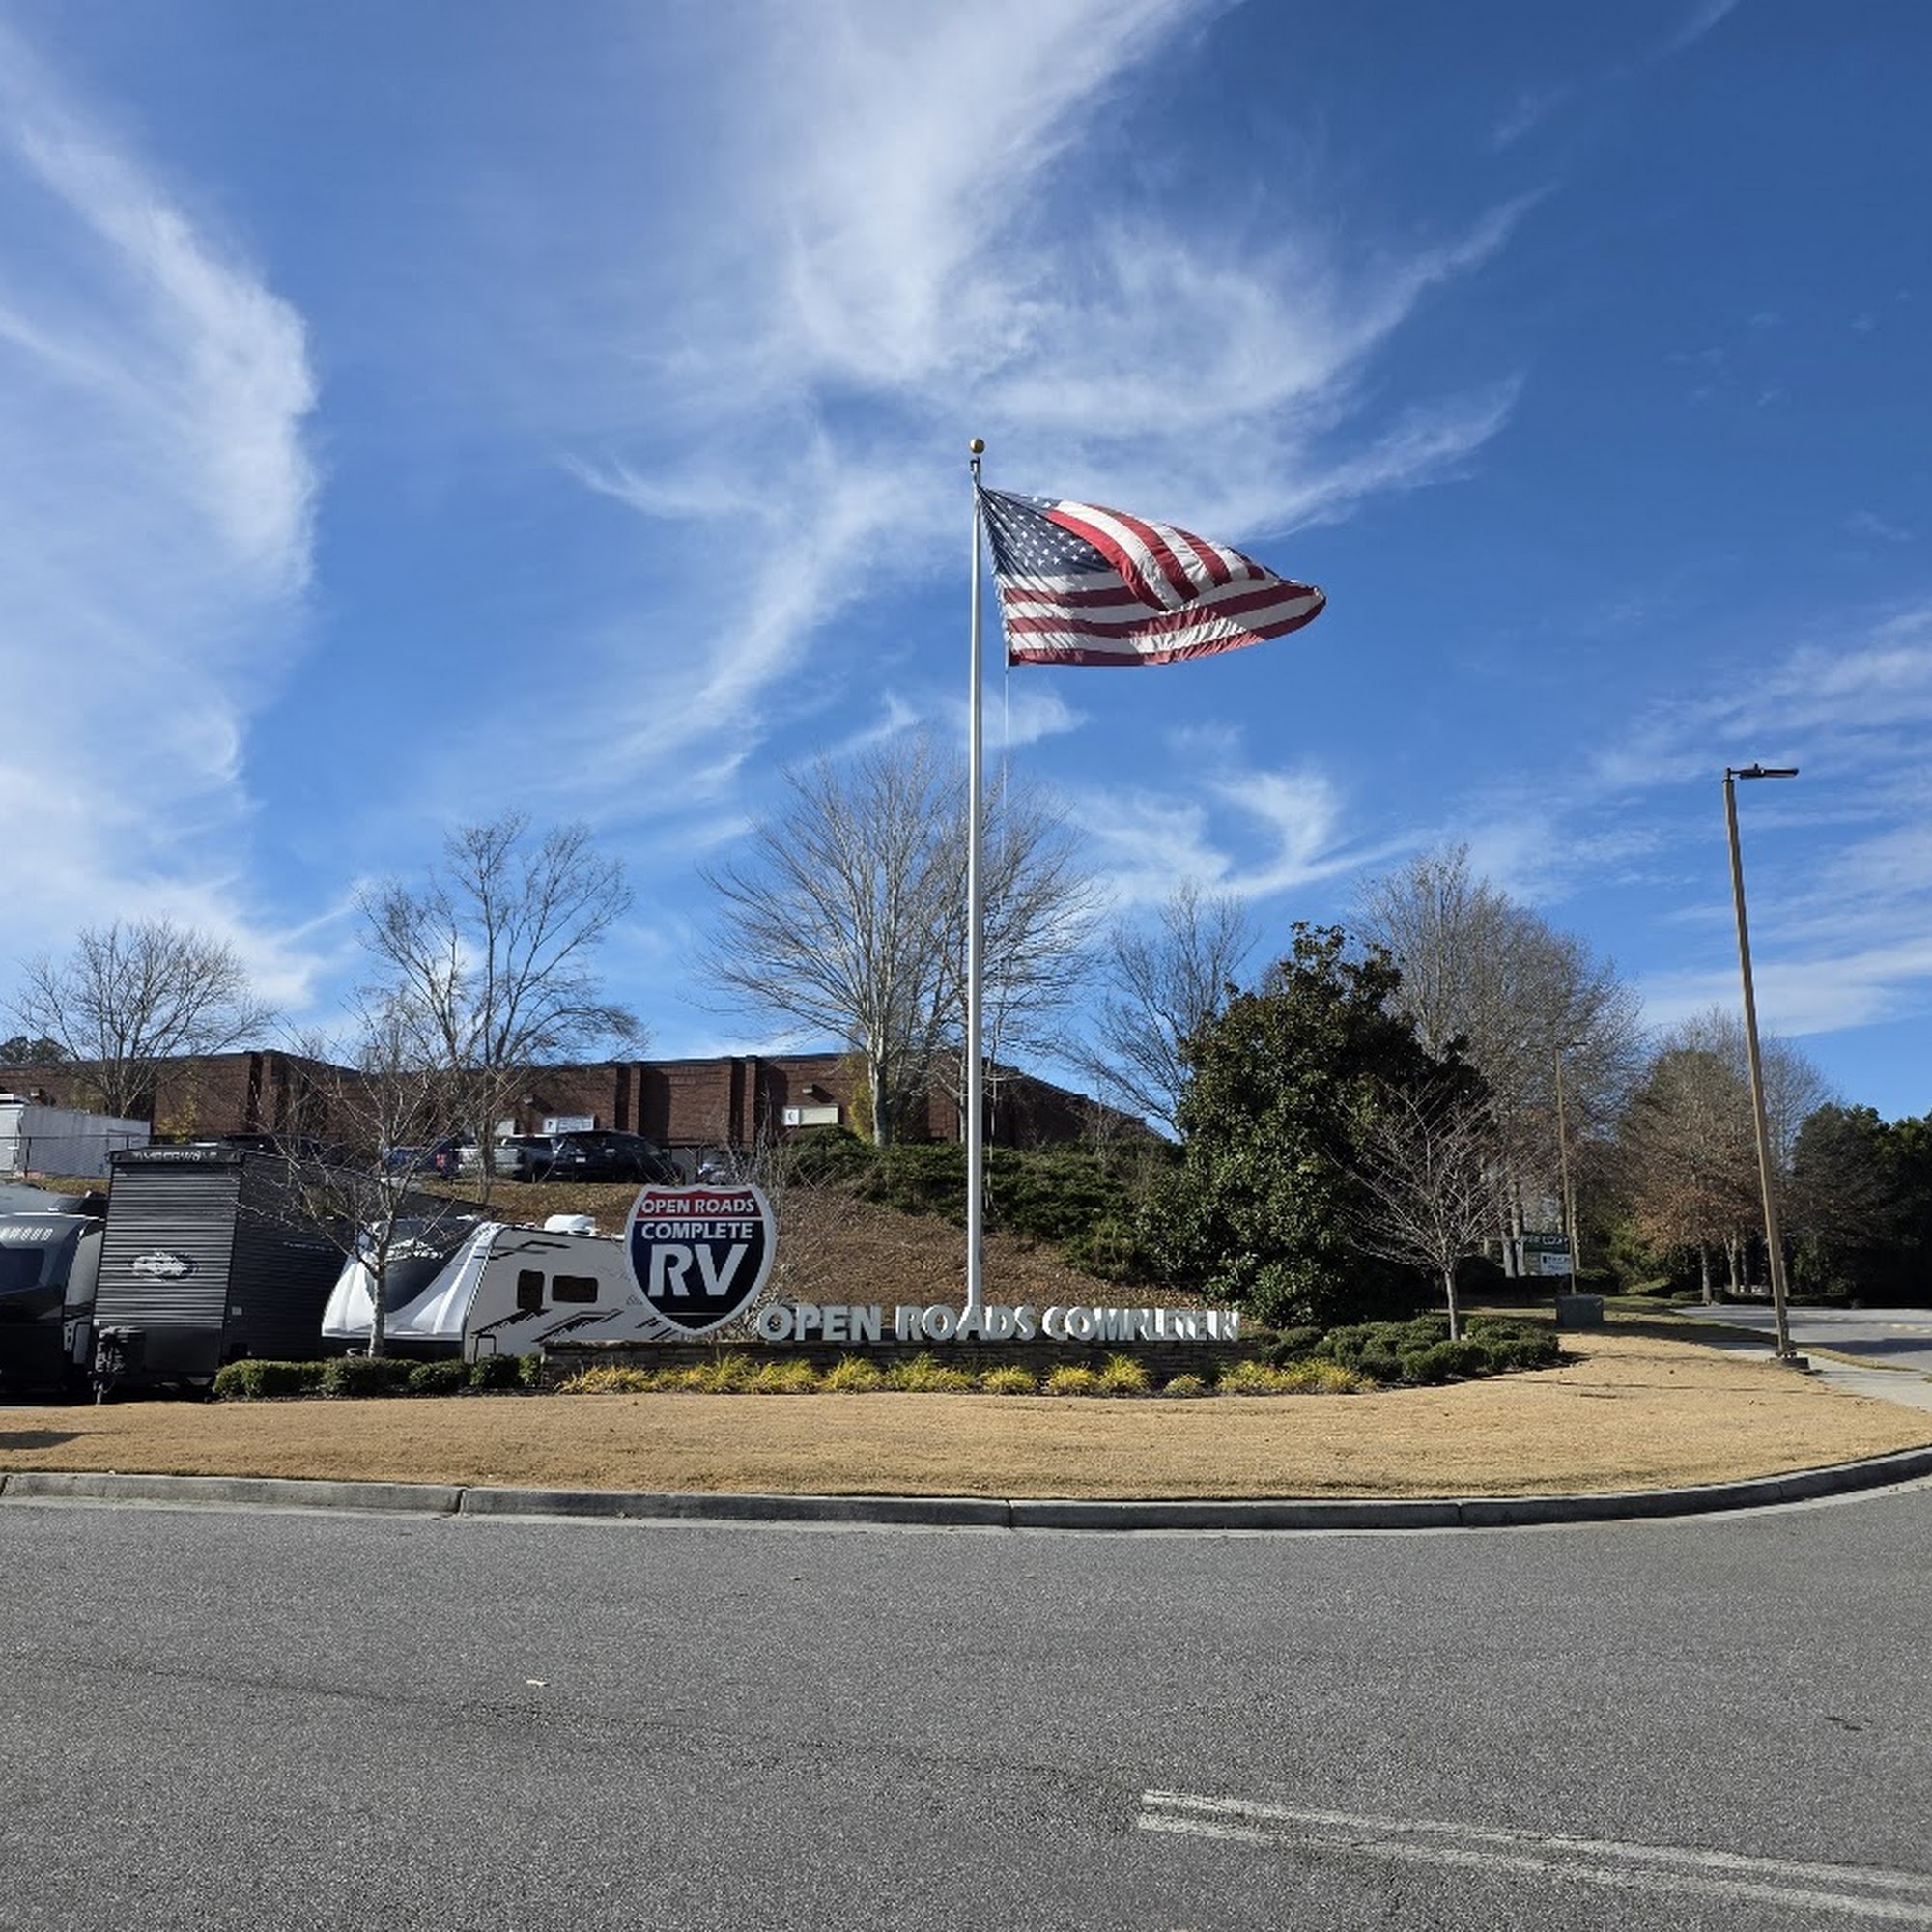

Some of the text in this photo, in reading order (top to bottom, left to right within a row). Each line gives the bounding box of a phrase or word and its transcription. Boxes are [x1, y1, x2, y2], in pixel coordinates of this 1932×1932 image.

[641, 1198, 754, 1214] OPEN ROADS
[641, 1222, 753, 1239] COMPLETE
[648, 1244, 749, 1297] RV
[757, 1304, 882, 1342] OPEN
[895, 1305, 1036, 1342] ROADS
